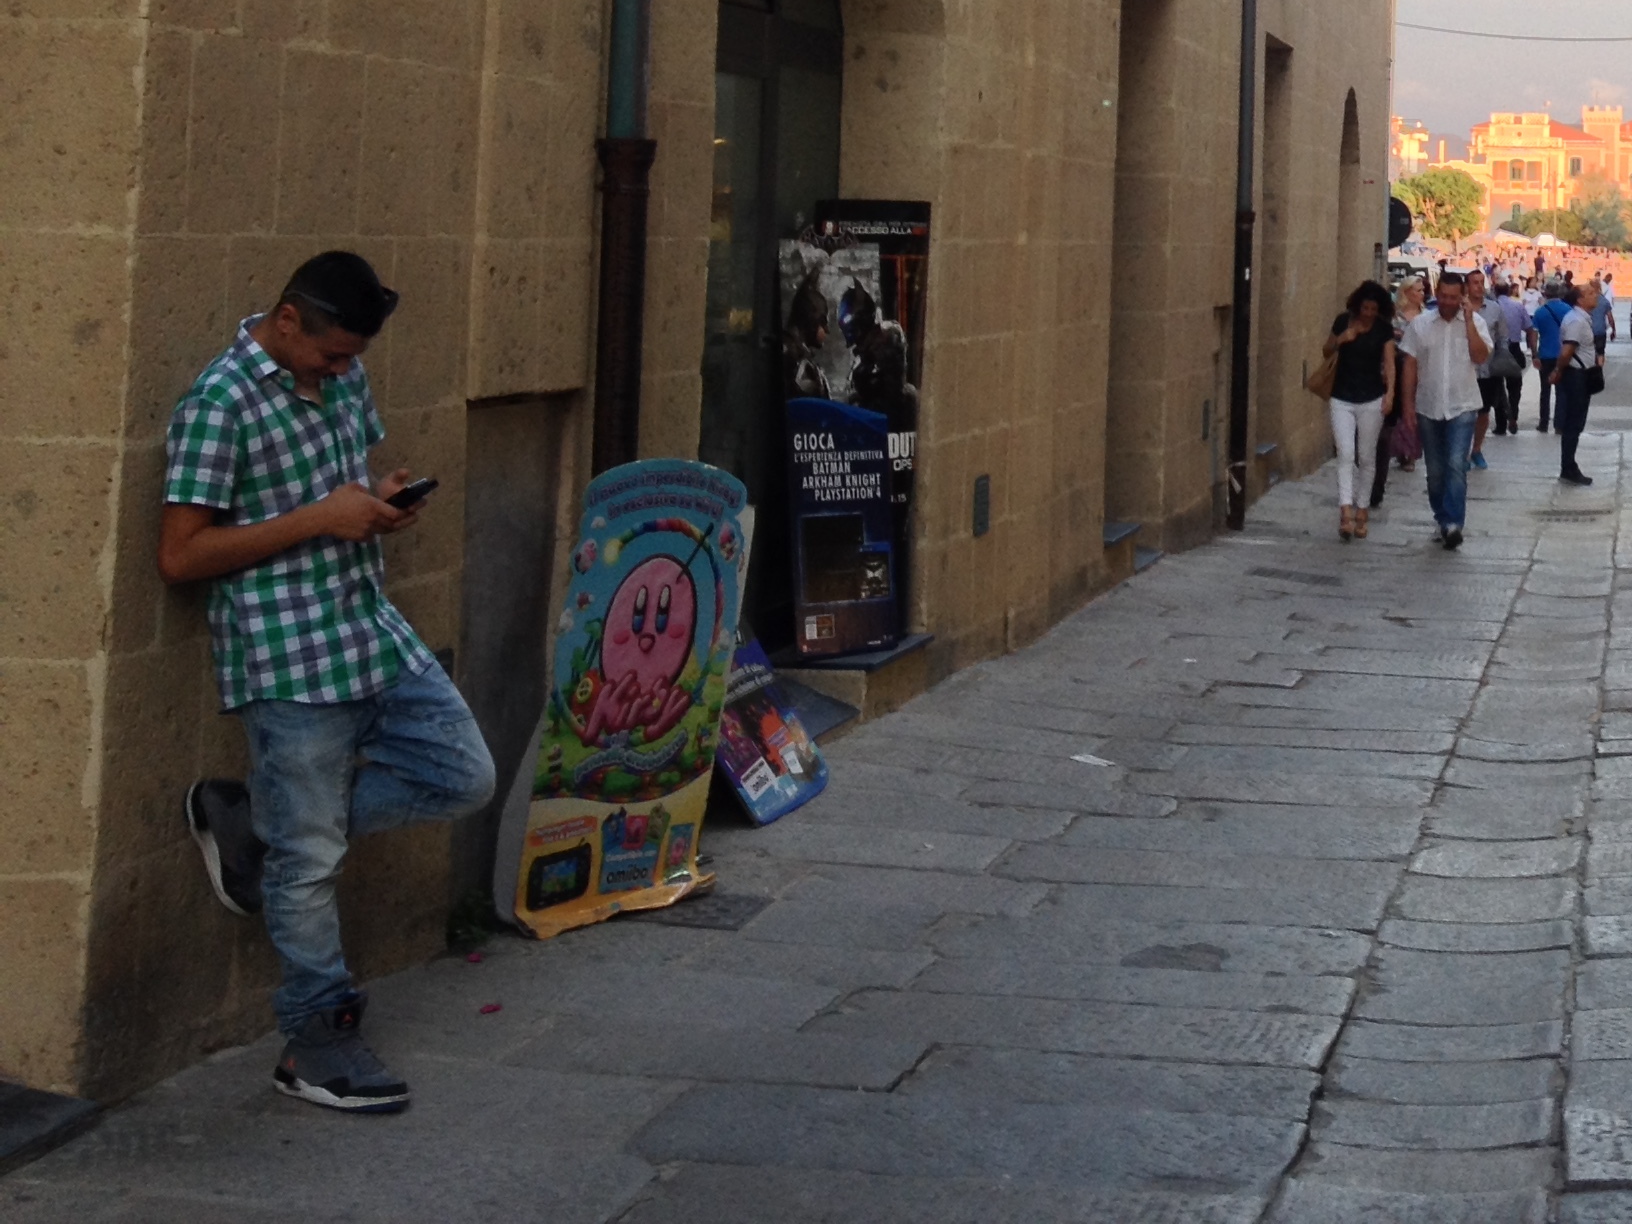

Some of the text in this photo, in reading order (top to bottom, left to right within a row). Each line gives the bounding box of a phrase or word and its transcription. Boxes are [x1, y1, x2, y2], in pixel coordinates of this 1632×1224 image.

[890, 226, 912, 235] ALLA
[793, 432, 835, 451] GIOCA
[794, 450, 883, 463] L'ESPERIENZA DEFINITIVA
[812, 462, 851, 475] BATMAN
[802, 472, 881, 489] ARKHAM KNIGHT
[815, 487, 874, 501] PLAYSTATION
[582, 668, 692, 747] Kirby
[606, 864, 649, 885] amiibo
